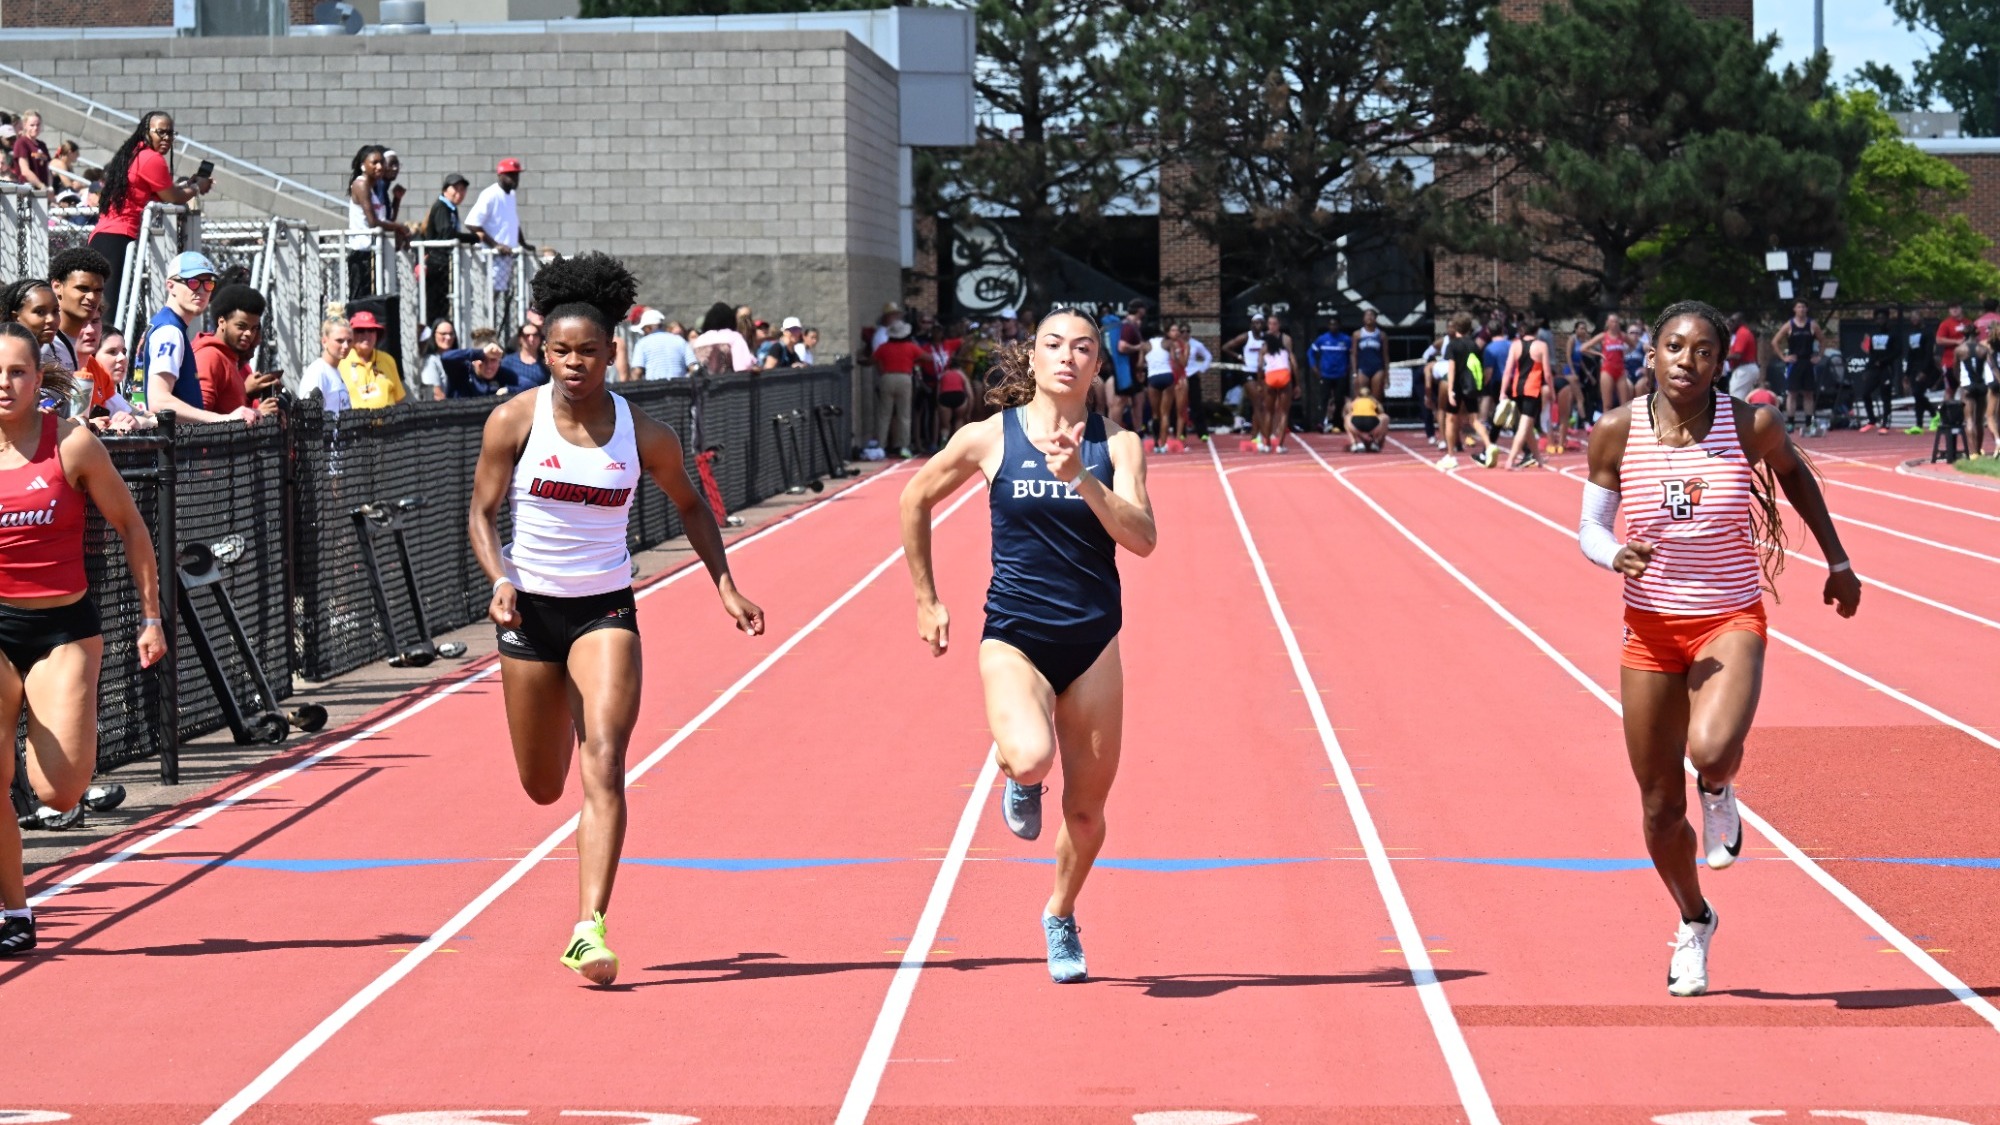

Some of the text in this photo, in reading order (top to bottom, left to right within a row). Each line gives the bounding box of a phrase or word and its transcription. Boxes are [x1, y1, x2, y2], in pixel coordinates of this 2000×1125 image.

[604, 462, 627, 471] ACC
[528, 477, 632, 507] LOUISVILLE
[1012, 480, 1084, 499] BUTL
[0, 499, 56, 527] ami
